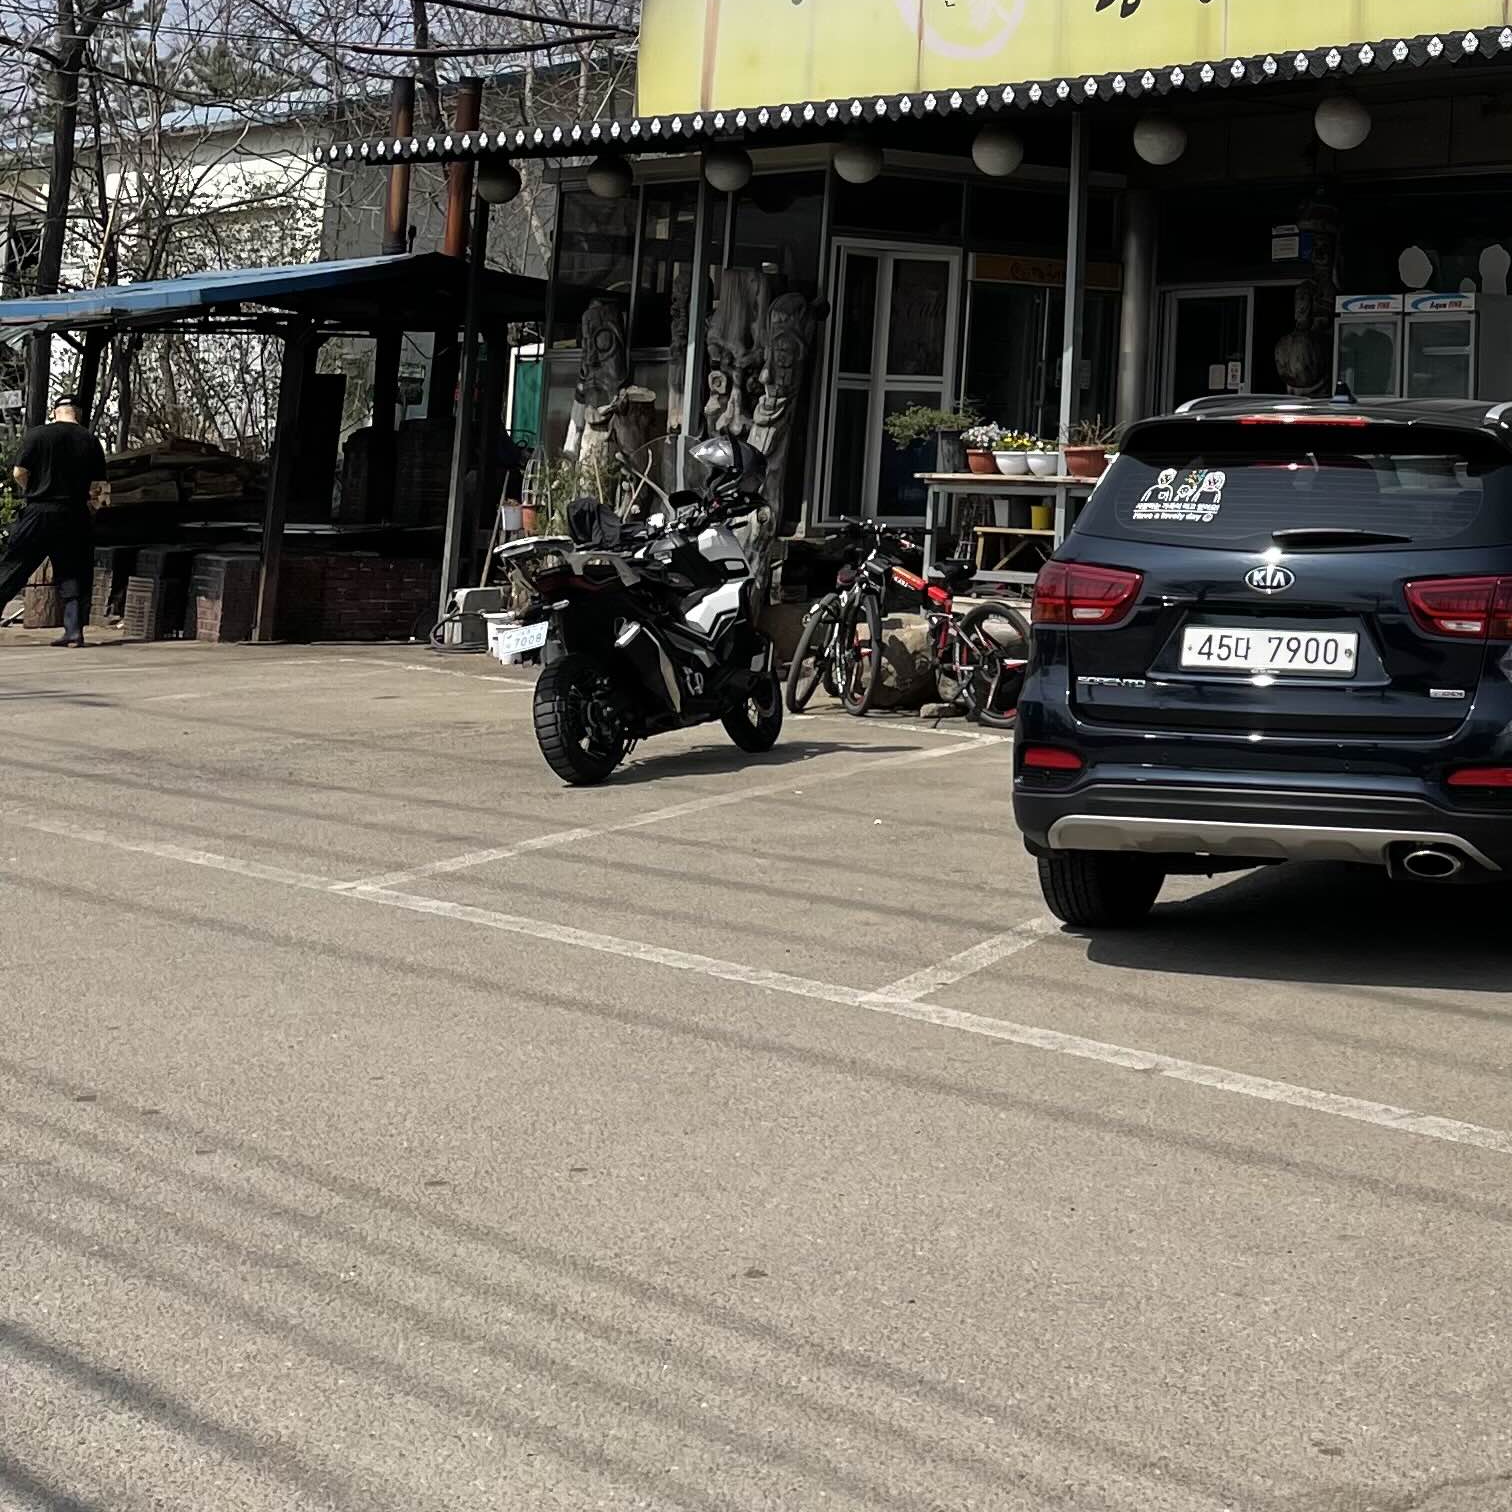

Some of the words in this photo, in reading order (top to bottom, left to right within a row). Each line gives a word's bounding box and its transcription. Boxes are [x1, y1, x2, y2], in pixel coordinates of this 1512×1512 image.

[1252, 569, 1287, 587] KIA
[1197, 633, 1251, 662] 45다
[1267, 636, 1340, 665] 7900
